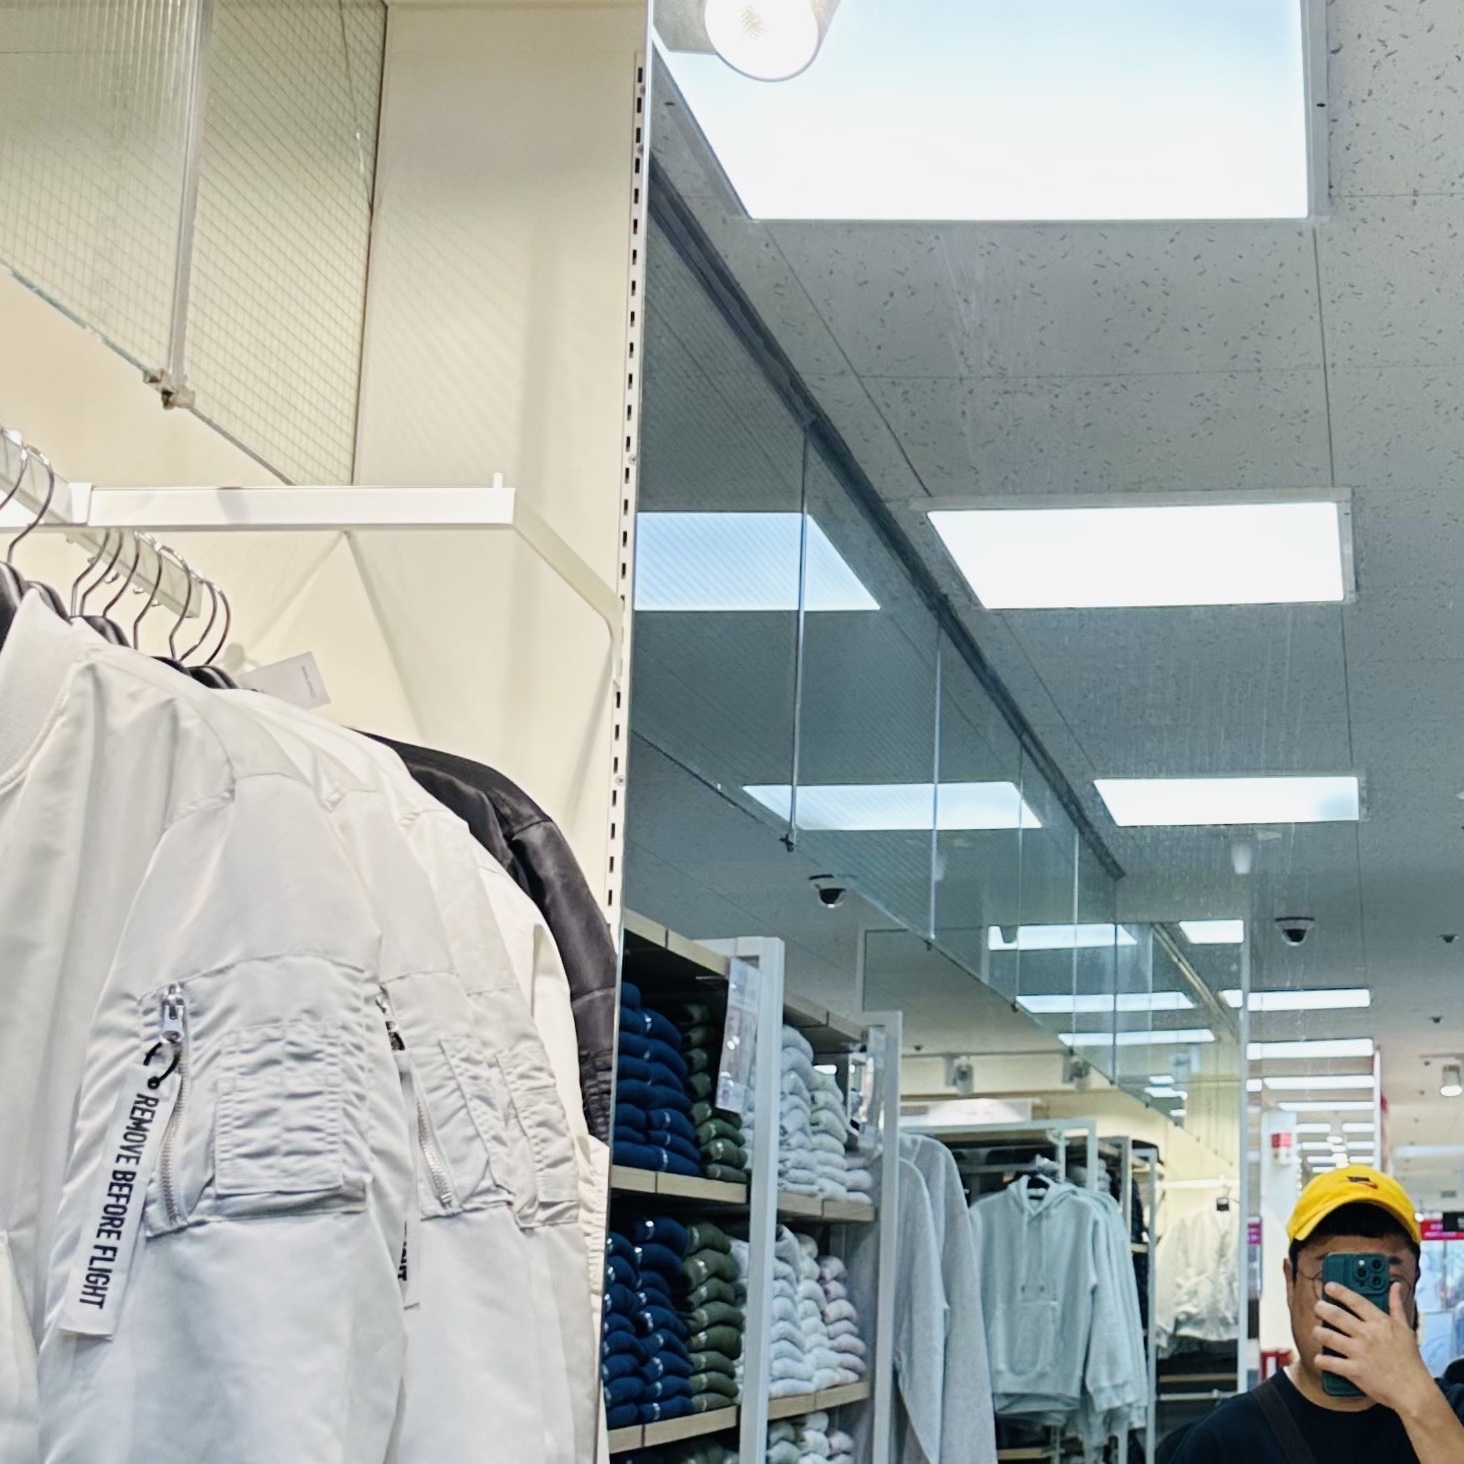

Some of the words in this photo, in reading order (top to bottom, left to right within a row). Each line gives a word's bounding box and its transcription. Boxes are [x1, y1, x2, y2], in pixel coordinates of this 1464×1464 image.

[115, 1093, 159, 1166] REMOVE
[96, 1169, 137, 1241] BEFORE
[79, 1244, 118, 1310] FLIGHT
